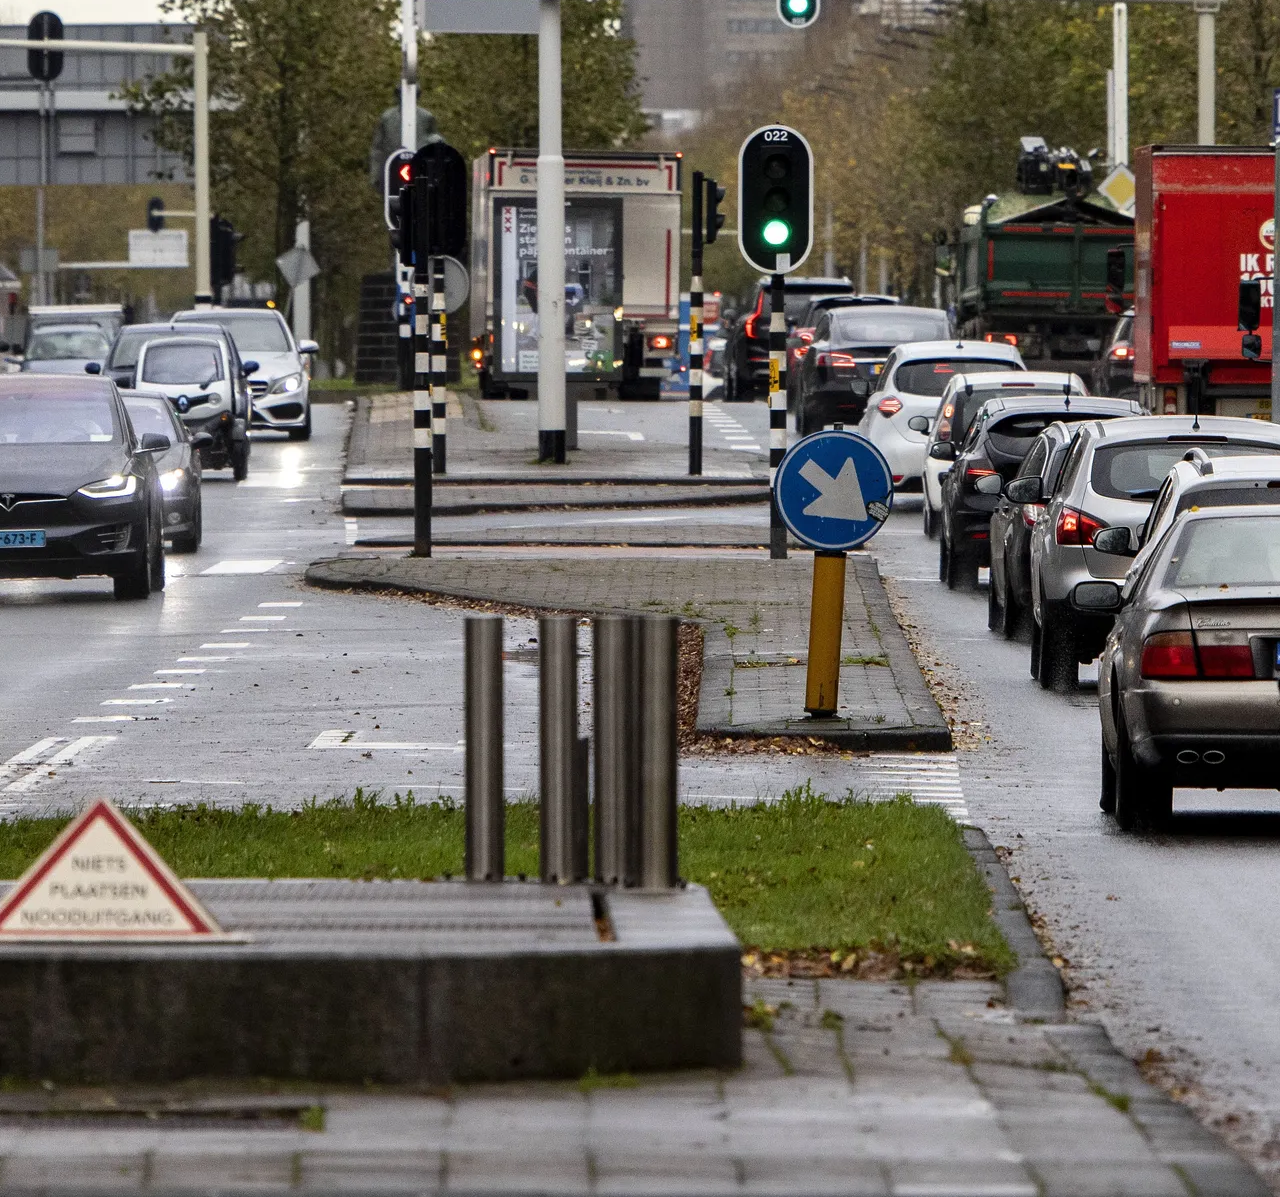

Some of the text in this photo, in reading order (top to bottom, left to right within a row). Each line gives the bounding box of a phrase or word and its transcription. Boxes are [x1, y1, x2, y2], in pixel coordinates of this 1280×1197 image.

[764, 130, 788, 141] 022
[71, 856, 128, 873] NIETS
[48, 881, 148, 899] PLAATSEN
[21, 907, 175, 926] NOODUITGANG
